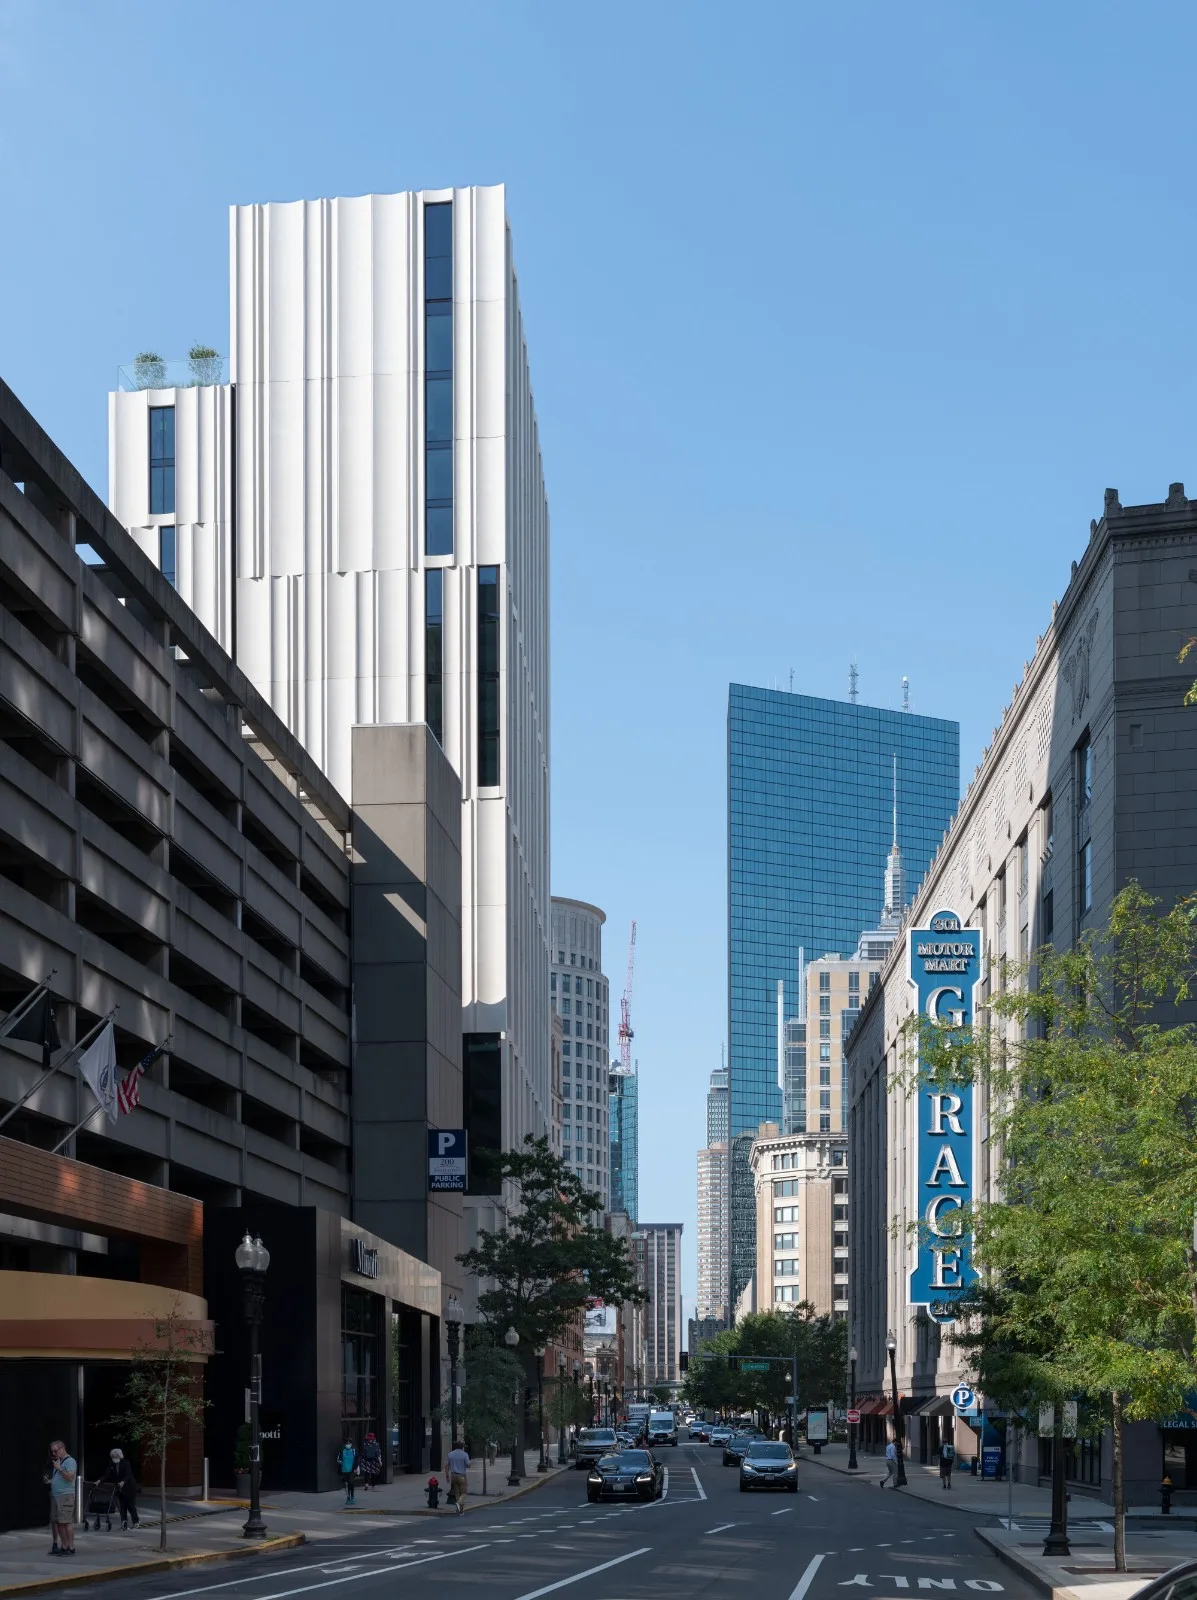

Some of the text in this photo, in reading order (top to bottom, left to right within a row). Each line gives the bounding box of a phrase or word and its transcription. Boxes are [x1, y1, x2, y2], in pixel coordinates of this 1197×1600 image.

[933, 919, 960, 931] 201
[917, 942, 974, 955] MOTOR
[924, 959, 968, 971] MART
[438, 1132, 456, 1155] P
[925, 986, 967, 1288] GRAGE
[957, 1390, 970, 1405] P
[1163, 1420, 1190, 1428] LEGAL
[837, 1574, 1005, 1591] ONLY
